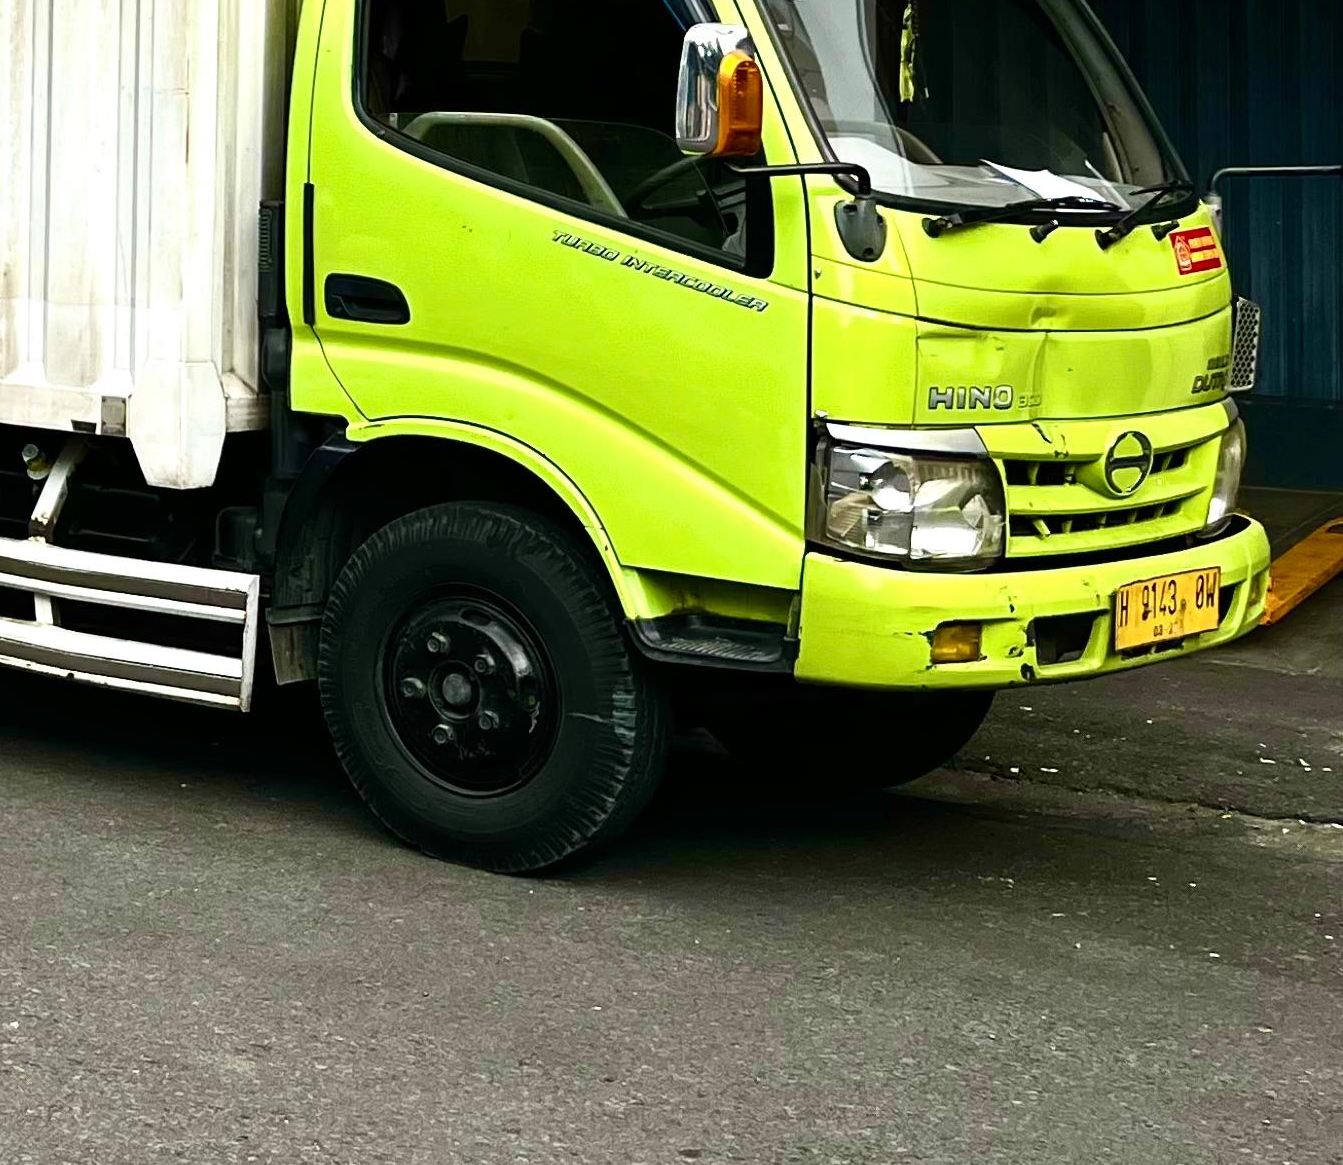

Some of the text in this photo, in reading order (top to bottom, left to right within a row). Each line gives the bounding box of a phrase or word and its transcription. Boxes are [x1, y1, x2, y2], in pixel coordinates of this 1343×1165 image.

[552, 230, 769, 313] TURBO INTERCOOLER
[928, 385, 1014, 410] HINO
[1119, 590, 1130, 628] H
